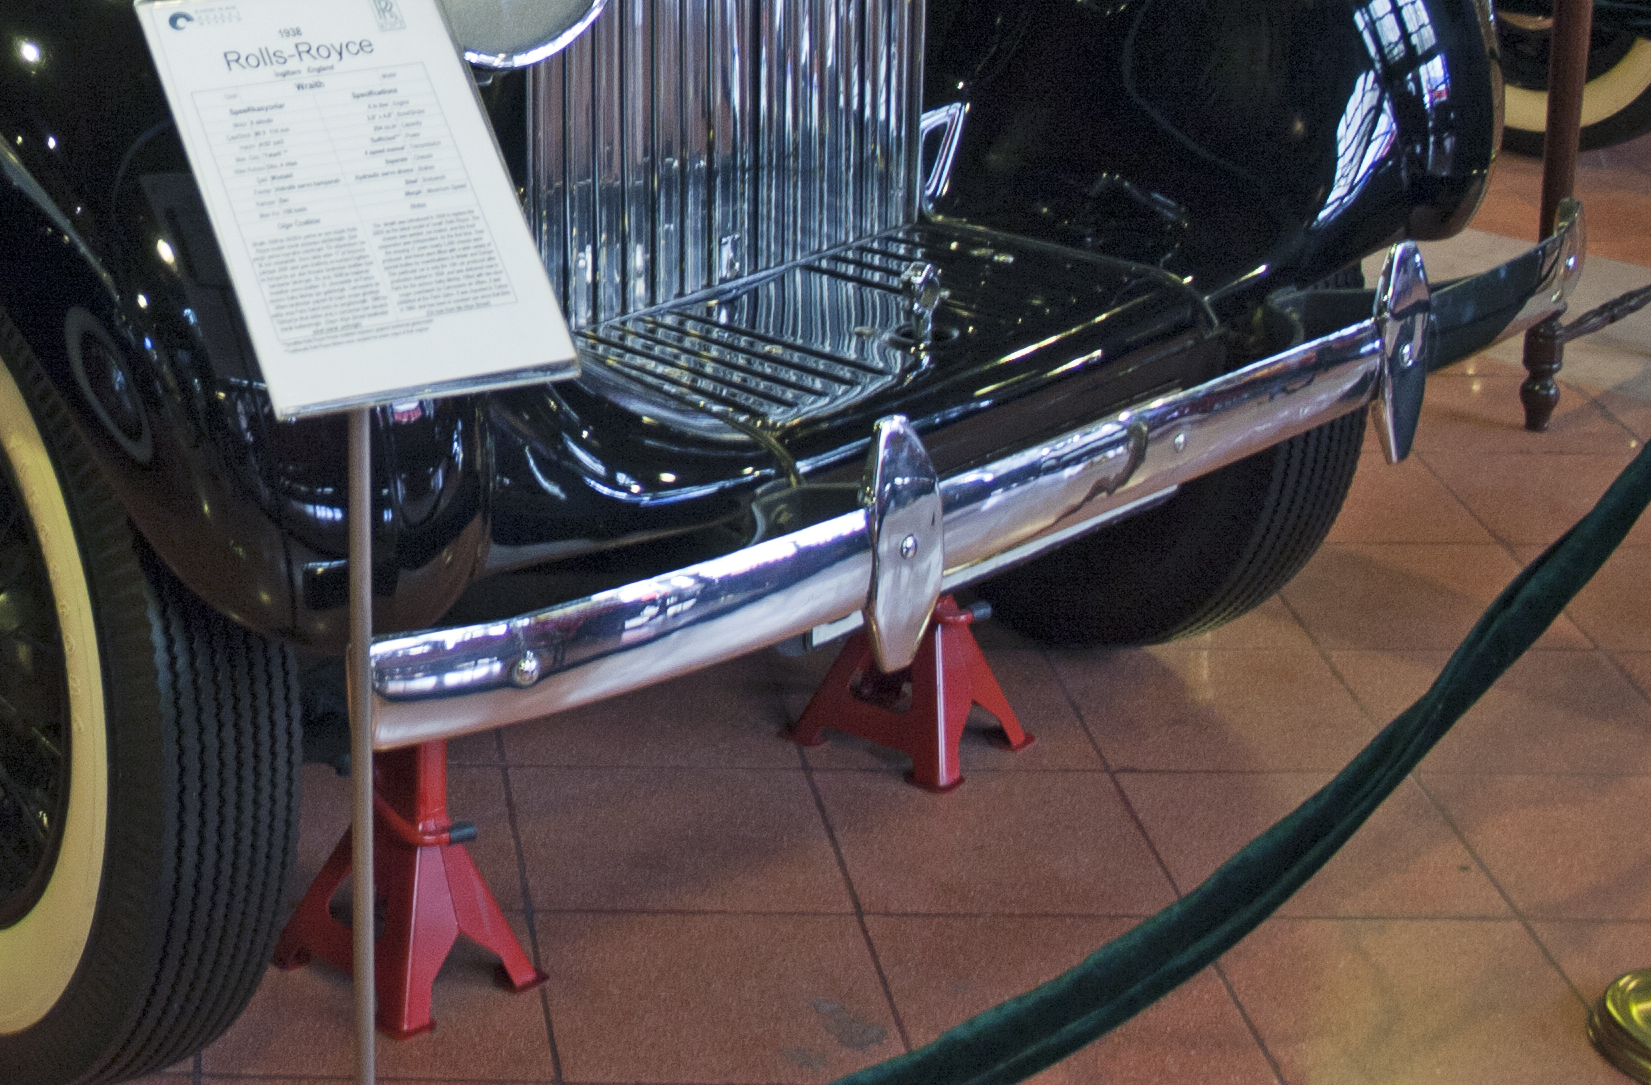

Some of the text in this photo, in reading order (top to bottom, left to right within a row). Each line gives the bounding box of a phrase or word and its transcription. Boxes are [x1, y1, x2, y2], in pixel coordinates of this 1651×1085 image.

[278, 27, 303, 38] 1938
[223, 37, 375, 72] Rolls-Royce
[295, 80, 324, 91] Wraith
